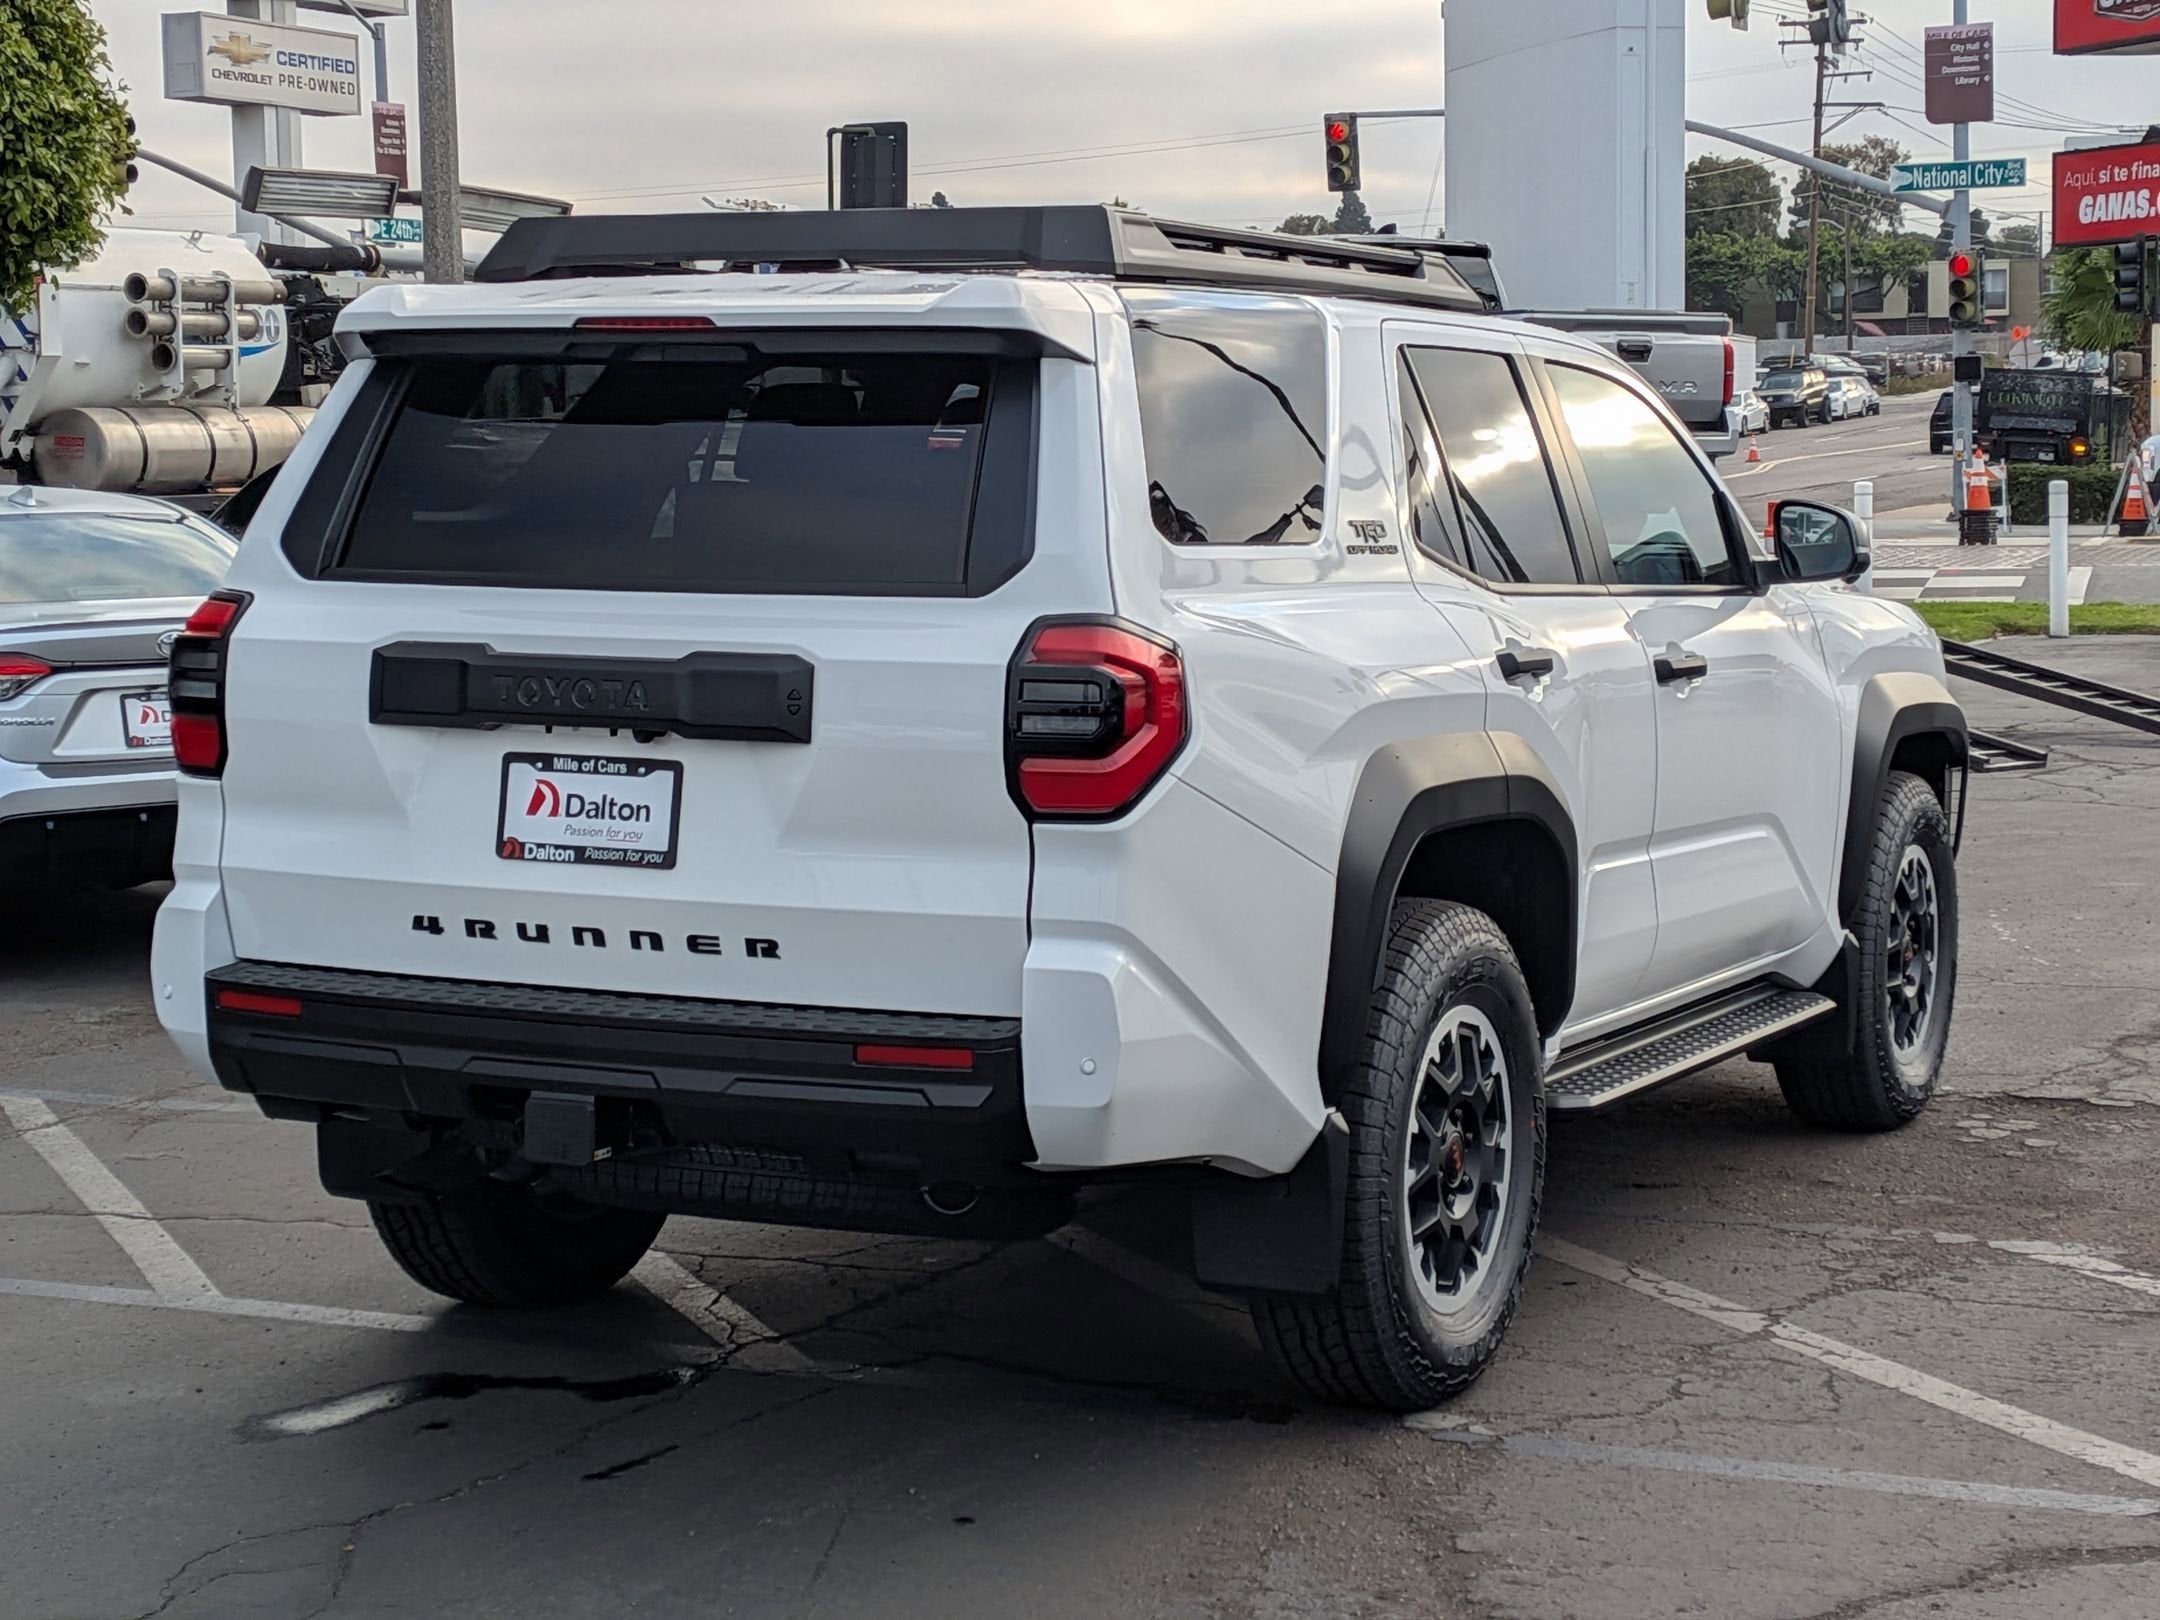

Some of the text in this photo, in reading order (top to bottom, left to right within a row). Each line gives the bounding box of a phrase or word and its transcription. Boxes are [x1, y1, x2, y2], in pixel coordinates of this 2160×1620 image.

[276, 50, 355, 74] CERTIFIED
[211, 68, 274, 86] CHEVROLET
[278, 73, 355, 96] PRE-OWNED
[1913, 163, 2003, 188] National City
[2064, 168, 2097, 189] Aquí,
[2099, 165, 2112, 184] sí
[2113, 166, 2129, 182] te
[381, 219, 390, 238] E
[390, 219, 413, 240] 24th
[1347, 519, 1388, 544] TRD
[493, 674, 650, 711] TOYOTA
[553, 757, 628, 774] Mile of Cars
[564, 793, 651, 823] Dalton
[563, 824, 643, 841] Passion for you
[523, 842, 664, 865] Dalton Passion for you
[411, 914, 782, 960] 4RUNNER
